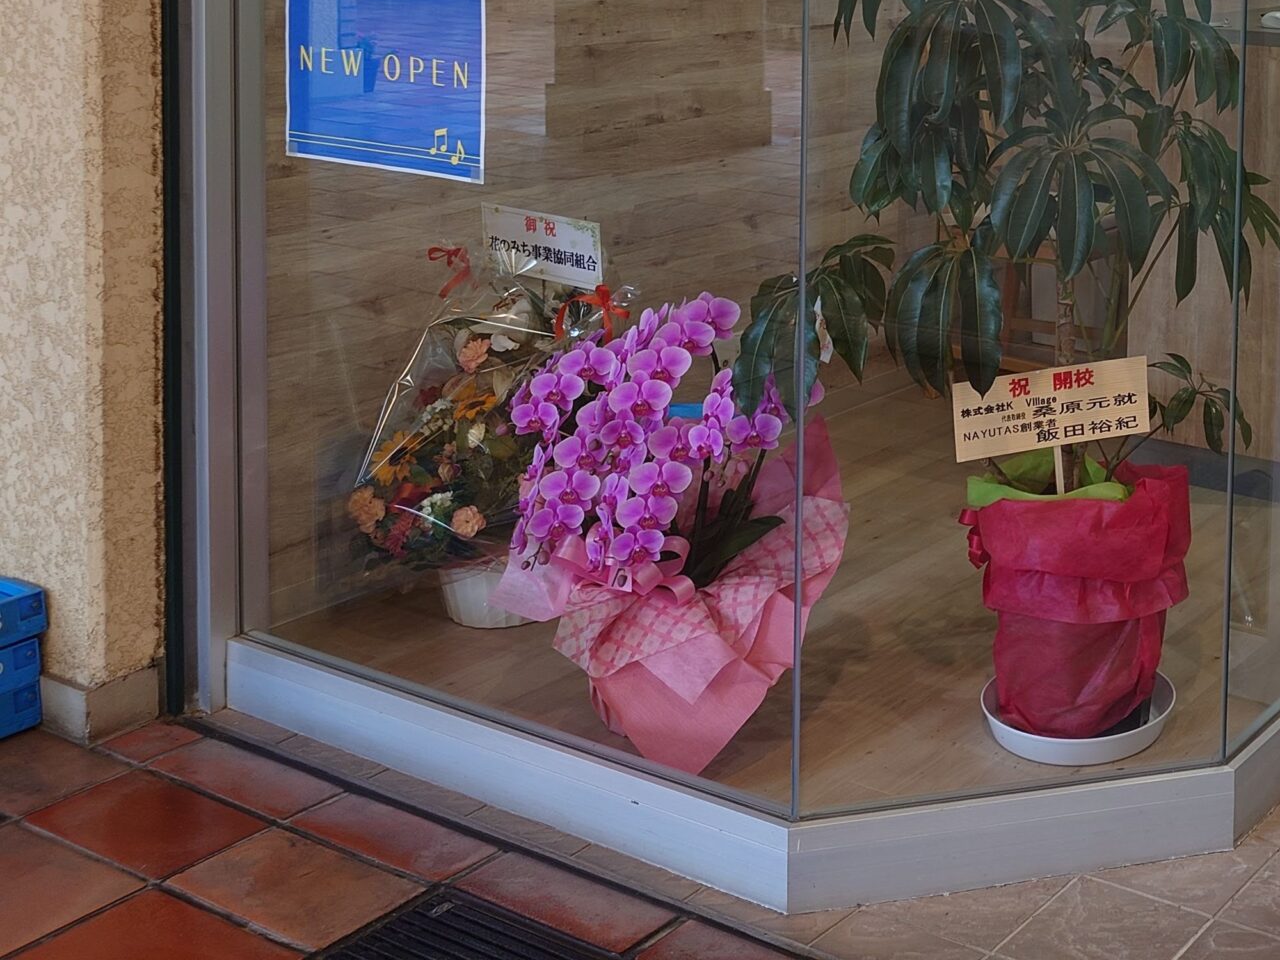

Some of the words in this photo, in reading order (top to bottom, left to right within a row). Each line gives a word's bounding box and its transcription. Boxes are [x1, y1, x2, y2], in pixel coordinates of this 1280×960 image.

[300, 44, 362, 77] NEW
[383, 53, 469, 90] OPEN
[489, 234, 598, 273] 花のみち事業協同組合
[1008, 377, 1031, 399] 祝
[1053, 367, 1095, 392] 開校
[960, 400, 1013, 420] 株式会社K
[1025, 396, 1058, 408] Village
[1036, 415, 1139, 444] 飯田裕紀
